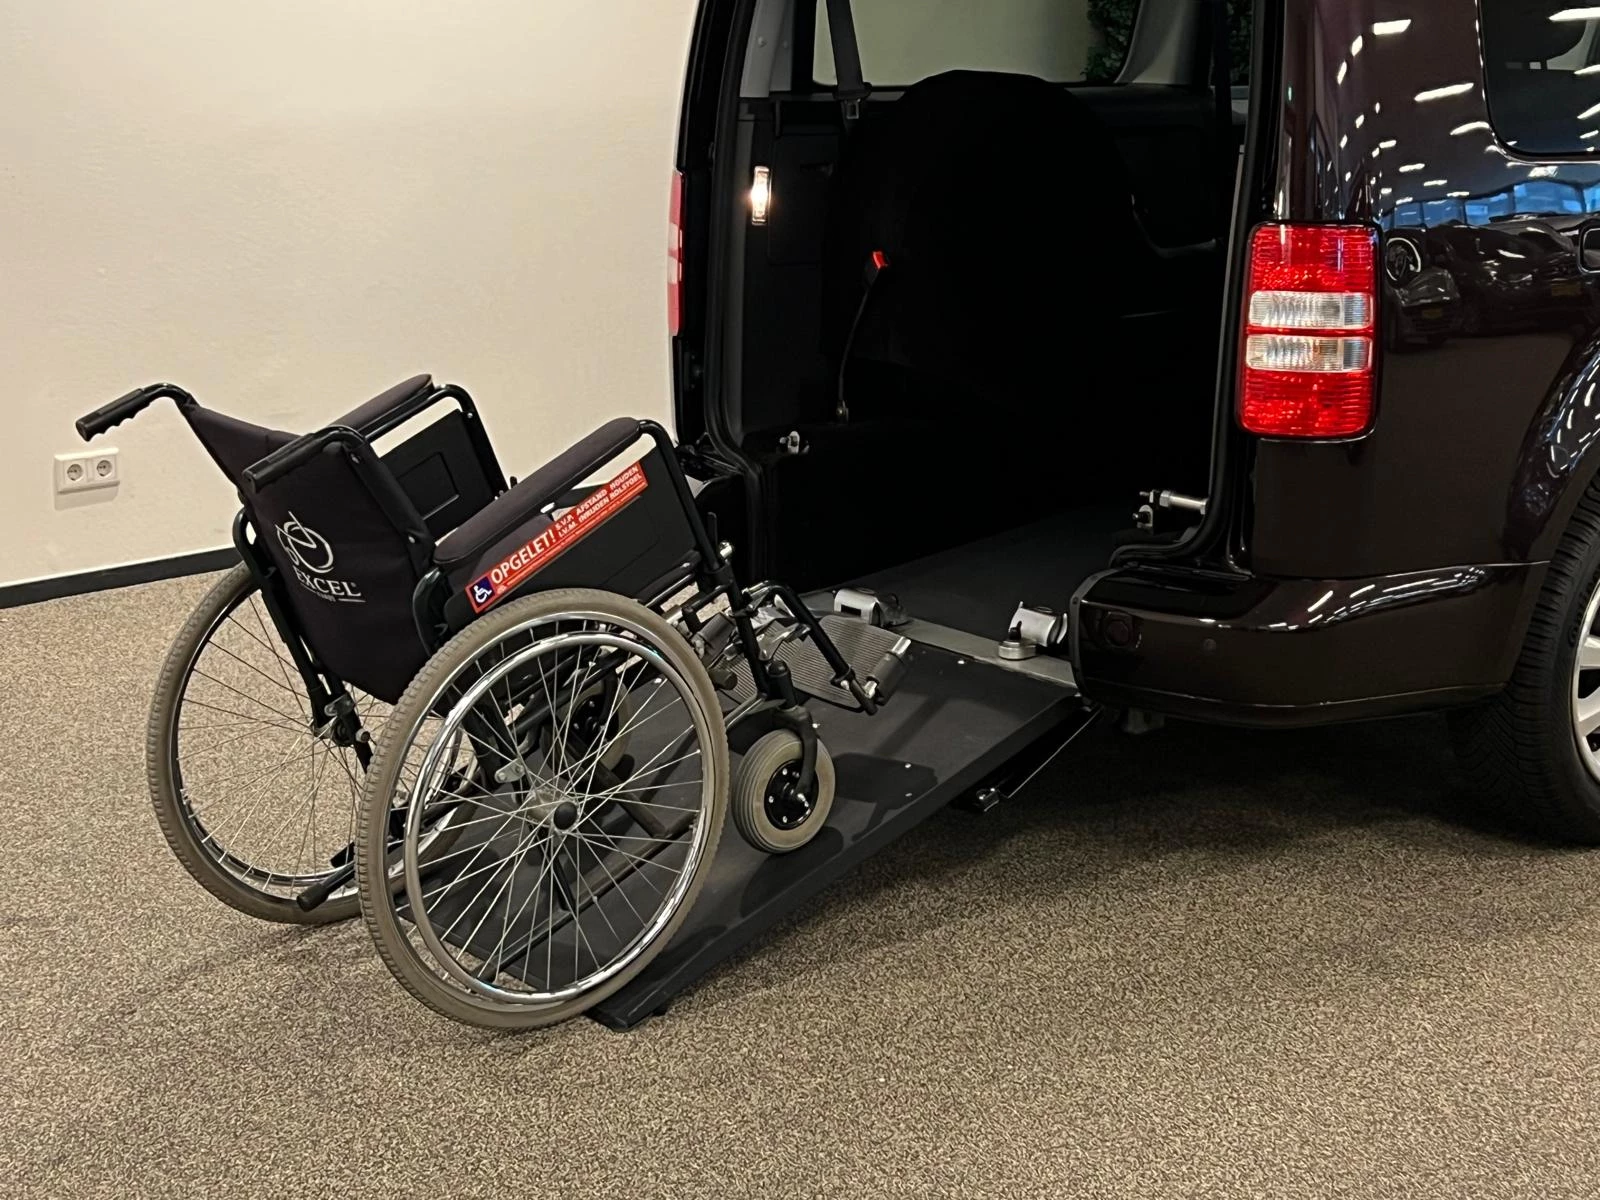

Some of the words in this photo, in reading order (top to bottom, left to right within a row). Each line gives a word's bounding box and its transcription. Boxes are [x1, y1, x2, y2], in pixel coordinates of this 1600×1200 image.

[576, 489, 608, 516] AFSTAND
[609, 465, 639, 490] HOUDEN
[609, 473, 642, 500] ROLSTOEL
[490, 528, 557, 584] OPGELET!
